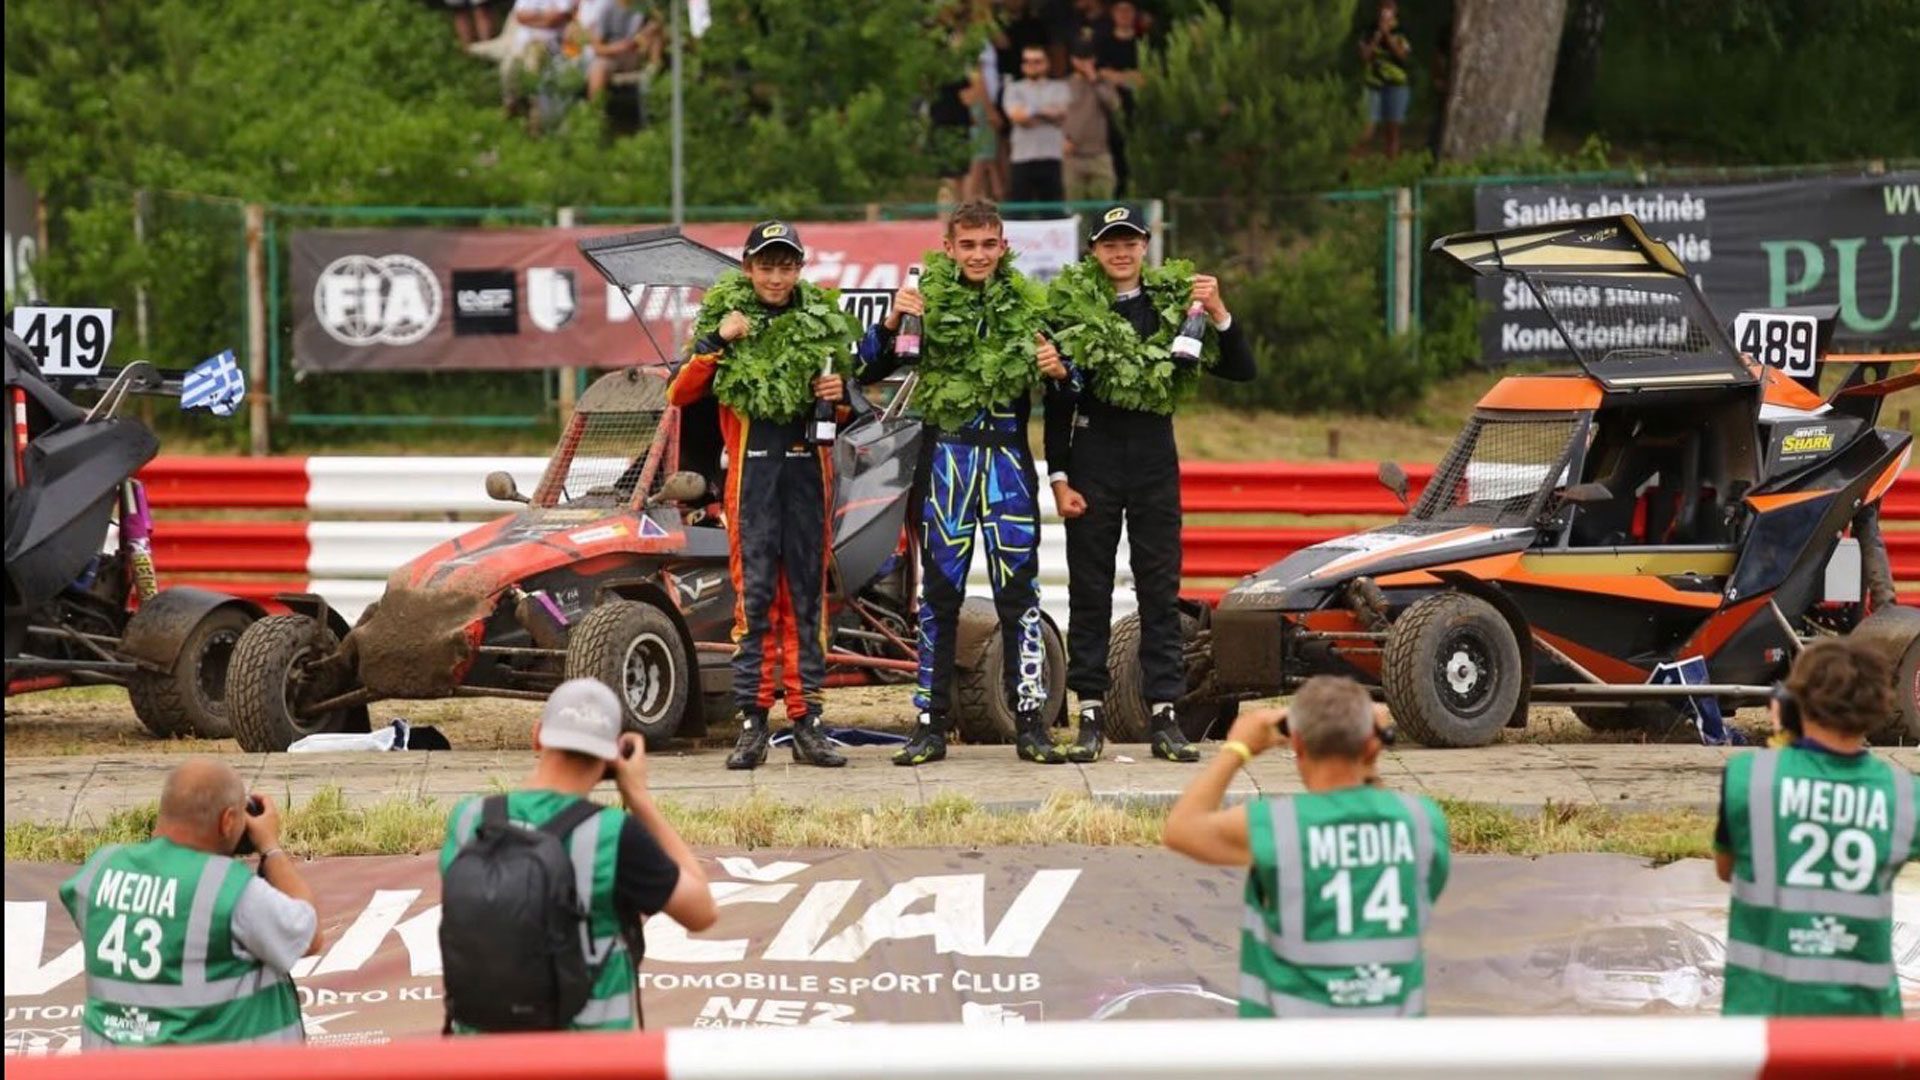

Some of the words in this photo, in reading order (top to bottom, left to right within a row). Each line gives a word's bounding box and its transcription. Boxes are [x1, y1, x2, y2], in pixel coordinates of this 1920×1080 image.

[1503, 195, 1582, 227] Saulės
[1587, 192, 1706, 222] elektrinės
[325, 273, 429, 325] FIA
[1761, 236, 1919, 331] PU
[23, 314, 105, 369] 419
[1740, 319, 1813, 371] 489
[1781, 434, 1834, 454] SHARK
[1018, 606, 1047, 712] sparco
[1779, 777, 1888, 831] MEDIA
[1308, 821, 1414, 869] MEDIA
[1786, 822, 1877, 893] 29
[95, 868, 177, 917] MEDIA
[1321, 866, 1408, 934] 14
[97, 914, 162, 980] 43
[639, 973, 819, 993] TOMOBILE
[829, 972, 943, 995] SPORT
[952, 970, 1041, 993] CLUB
